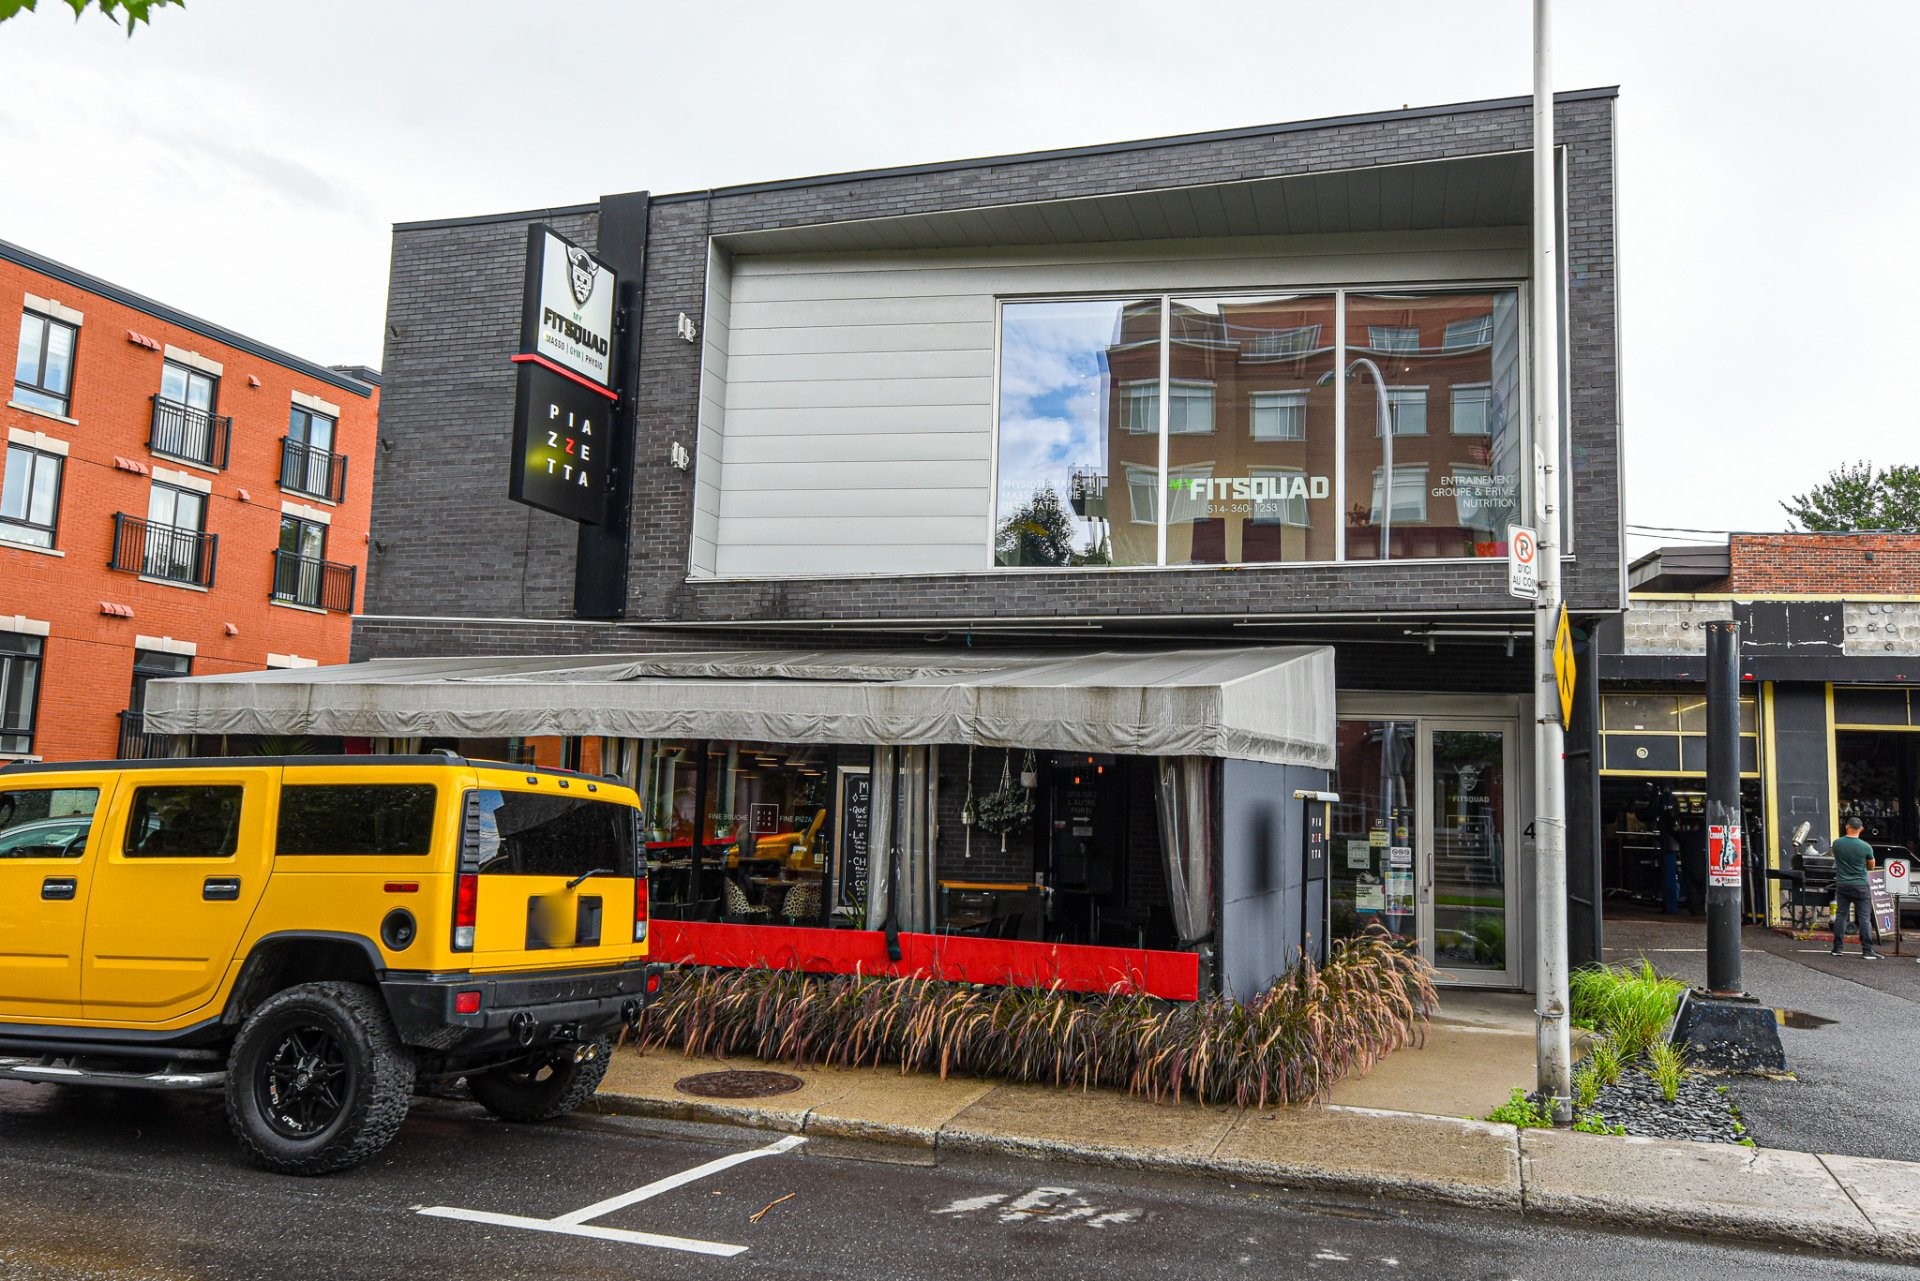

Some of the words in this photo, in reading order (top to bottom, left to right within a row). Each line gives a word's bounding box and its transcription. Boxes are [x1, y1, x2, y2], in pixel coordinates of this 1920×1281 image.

[573, 312, 582, 322] MY
[544, 307, 608, 357] FITSQUAD
[545, 334, 565, 351] MASSO
[570, 346, 581, 358] GYM
[585, 355, 603, 370] PHYSIO
[1441, 475, 1516, 486] ENTRAINEMENT
[1432, 487, 1471, 497] GROUPE
[1475, 487, 1482, 496] &
[1464, 499, 1516, 508] NUTRITION
[1513, 576, 1521, 586] AU
[723, 813, 748, 821] BOUCHE
